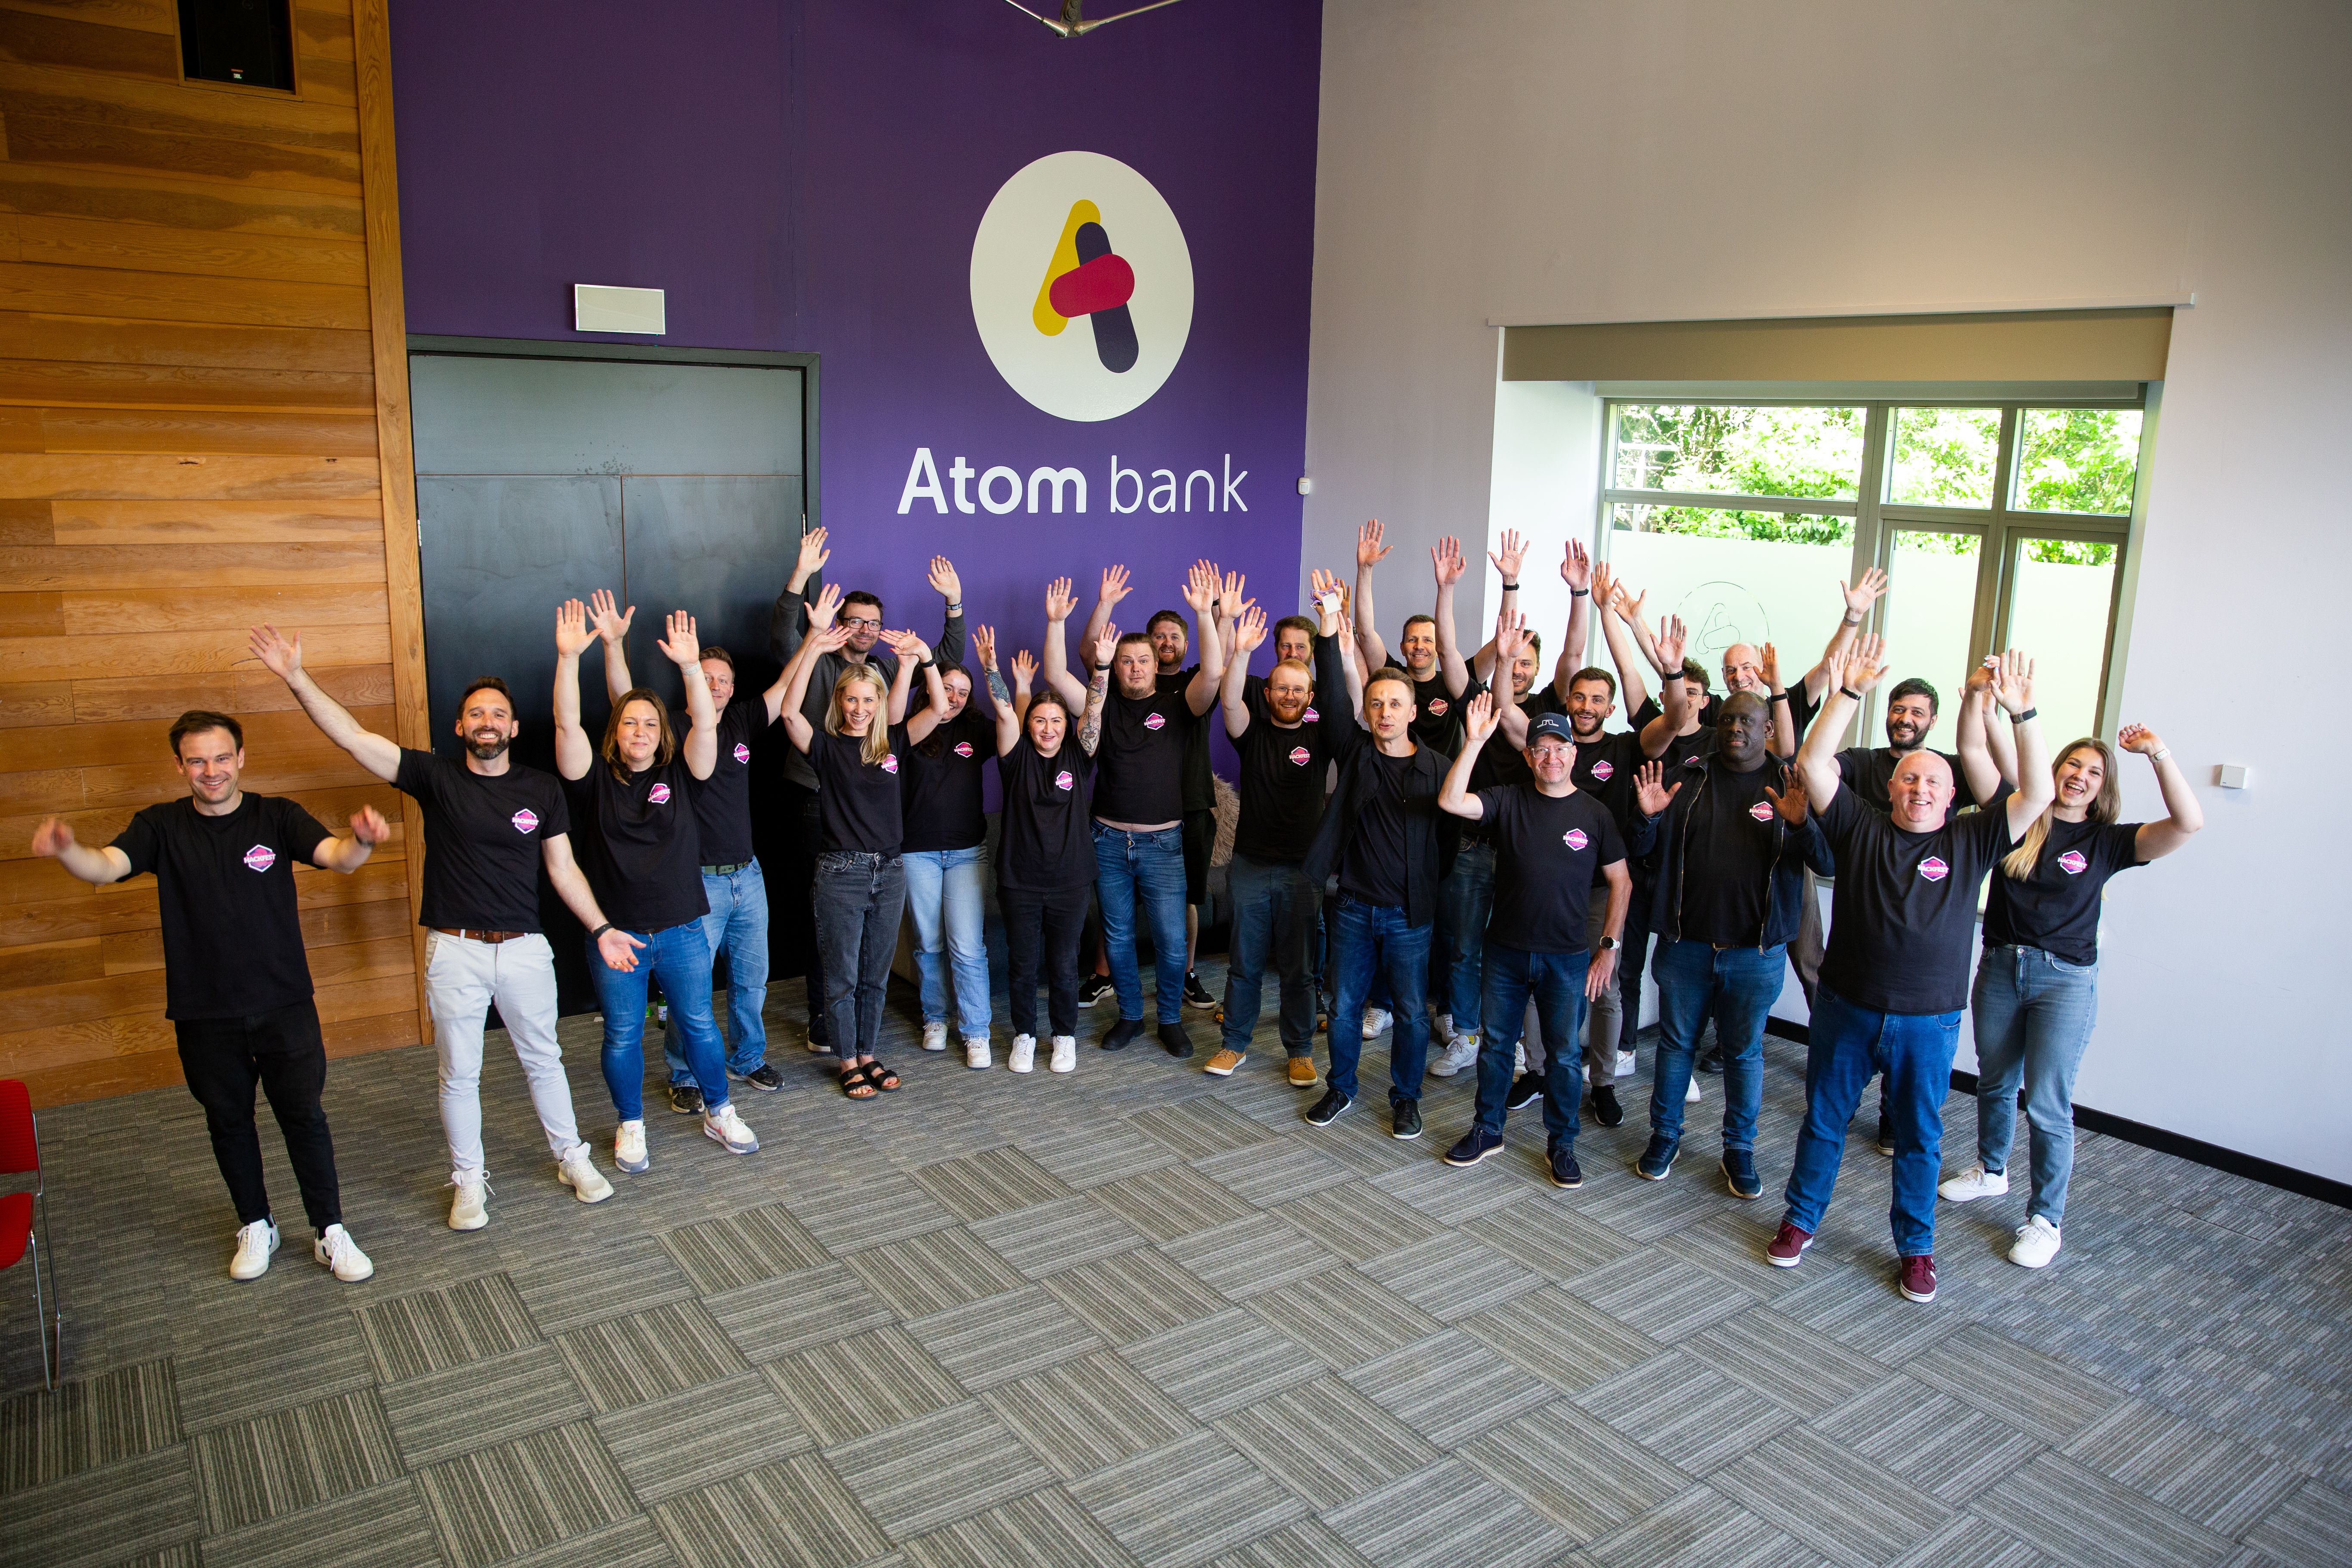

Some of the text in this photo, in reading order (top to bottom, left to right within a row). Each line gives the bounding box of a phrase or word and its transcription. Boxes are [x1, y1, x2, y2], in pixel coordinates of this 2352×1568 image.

[897, 447, 1248, 514] Atom bank
[1428, 703, 1448, 711] HACKFEST
[648, 789, 670, 802] HACKFEST
[512, 817, 539, 826] HACKFEST
[1563, 836, 1588, 845] HACKFEST
[244, 854, 276, 864] HACKFEST
[2058, 857, 2087, 869] HACKFEST
[1917, 865, 1949, 873] HACKFEST
